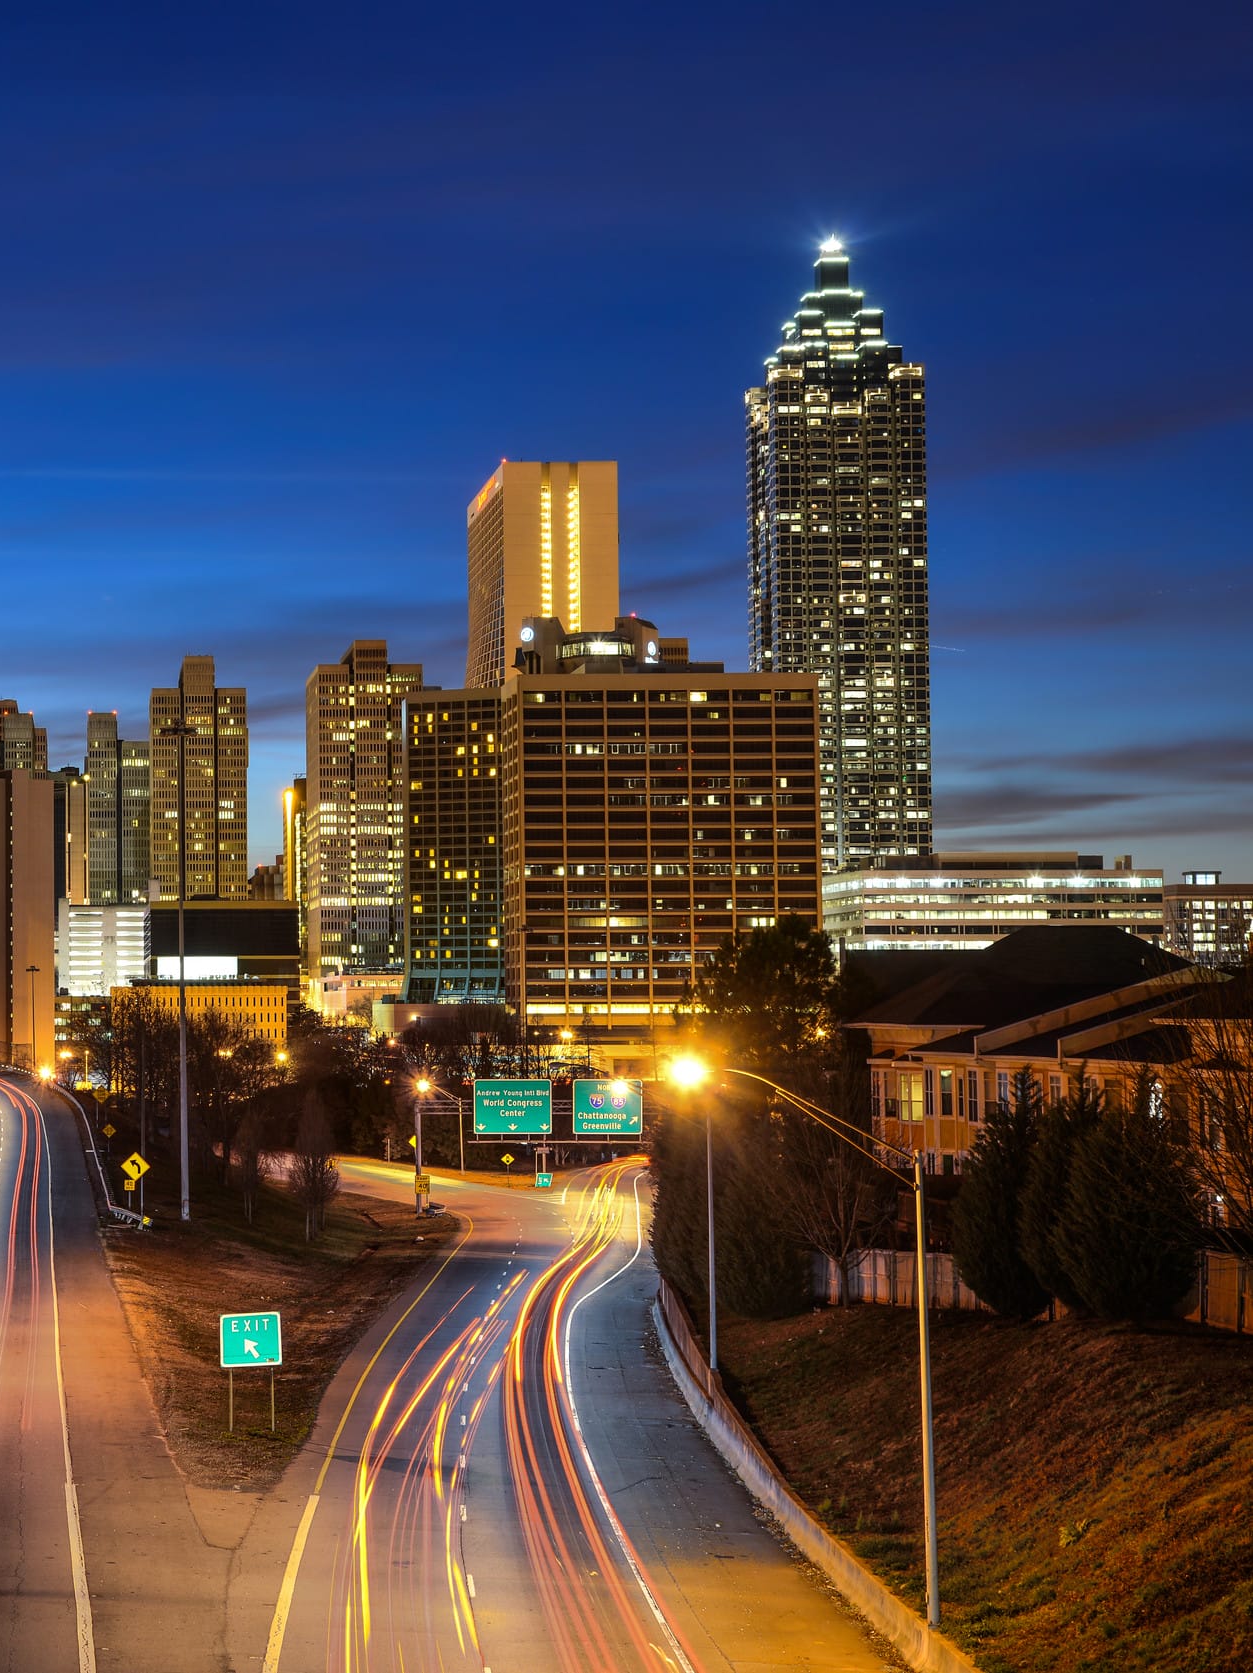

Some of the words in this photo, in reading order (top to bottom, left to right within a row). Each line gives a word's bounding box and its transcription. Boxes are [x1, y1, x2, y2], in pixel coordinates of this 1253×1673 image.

[483, 1099, 505, 1107] World
[507, 1099, 543, 1108] Congress
[592, 1097, 602, 1105] 75
[613, 1098, 624, 1106] 85
[499, 1109, 526, 1117] Center
[577, 1112, 627, 1122] Chattanooga
[582, 1121, 622, 1130] Greenville
[231, 1318, 270, 1333] EXIT
